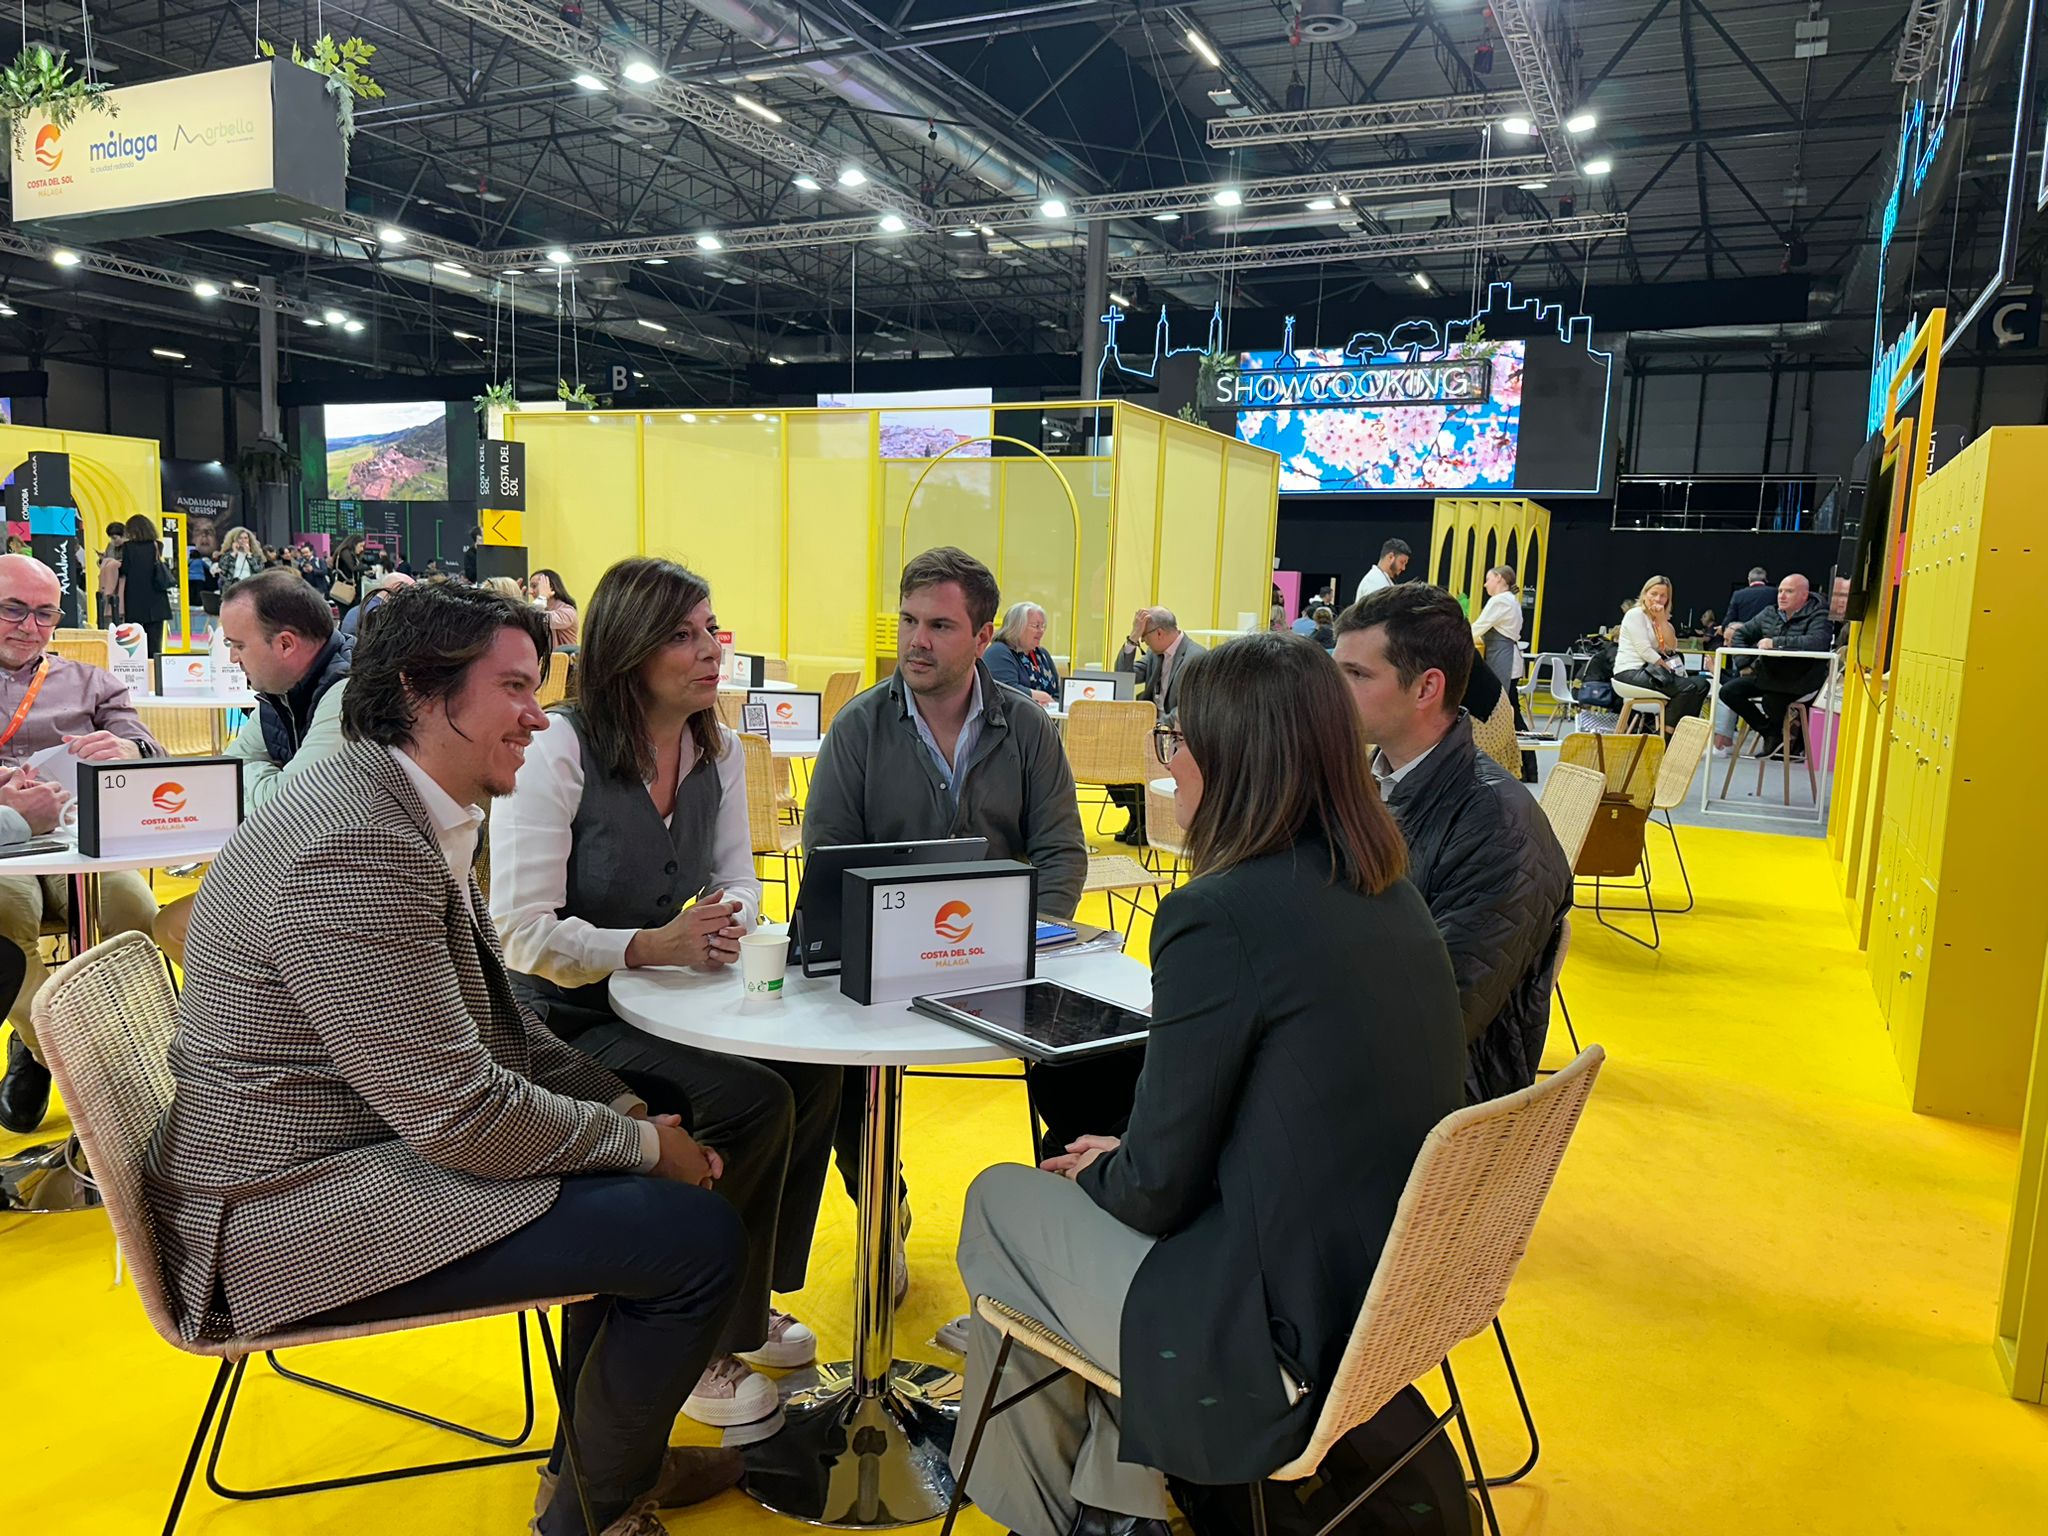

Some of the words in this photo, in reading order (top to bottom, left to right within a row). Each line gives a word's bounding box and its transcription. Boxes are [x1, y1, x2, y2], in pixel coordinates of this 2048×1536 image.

[173, 118, 254, 151] Marbella
[27, 179, 47, 189] COSTA
[48, 177, 60, 186] DEL
[61, 175, 74, 184] SOL
[612, 366, 628, 391] B
[1216, 367, 1468, 403] SHOWCOOKING
[500, 444, 510, 463] DEL
[500, 464, 510, 496] COSTA
[510, 477, 519, 497] SOL
[104, 774, 126, 789] 10
[141, 817, 166, 825] COSTA
[168, 816, 183, 824] DEL
[184, 815, 199, 823] SOL
[881, 890, 906, 910] 13
[920, 950, 949, 960] COSTA
[950, 948, 967, 957] DEL
[968, 947, 985, 956] SOL
[935, 958, 970, 968] MÁLAGA
